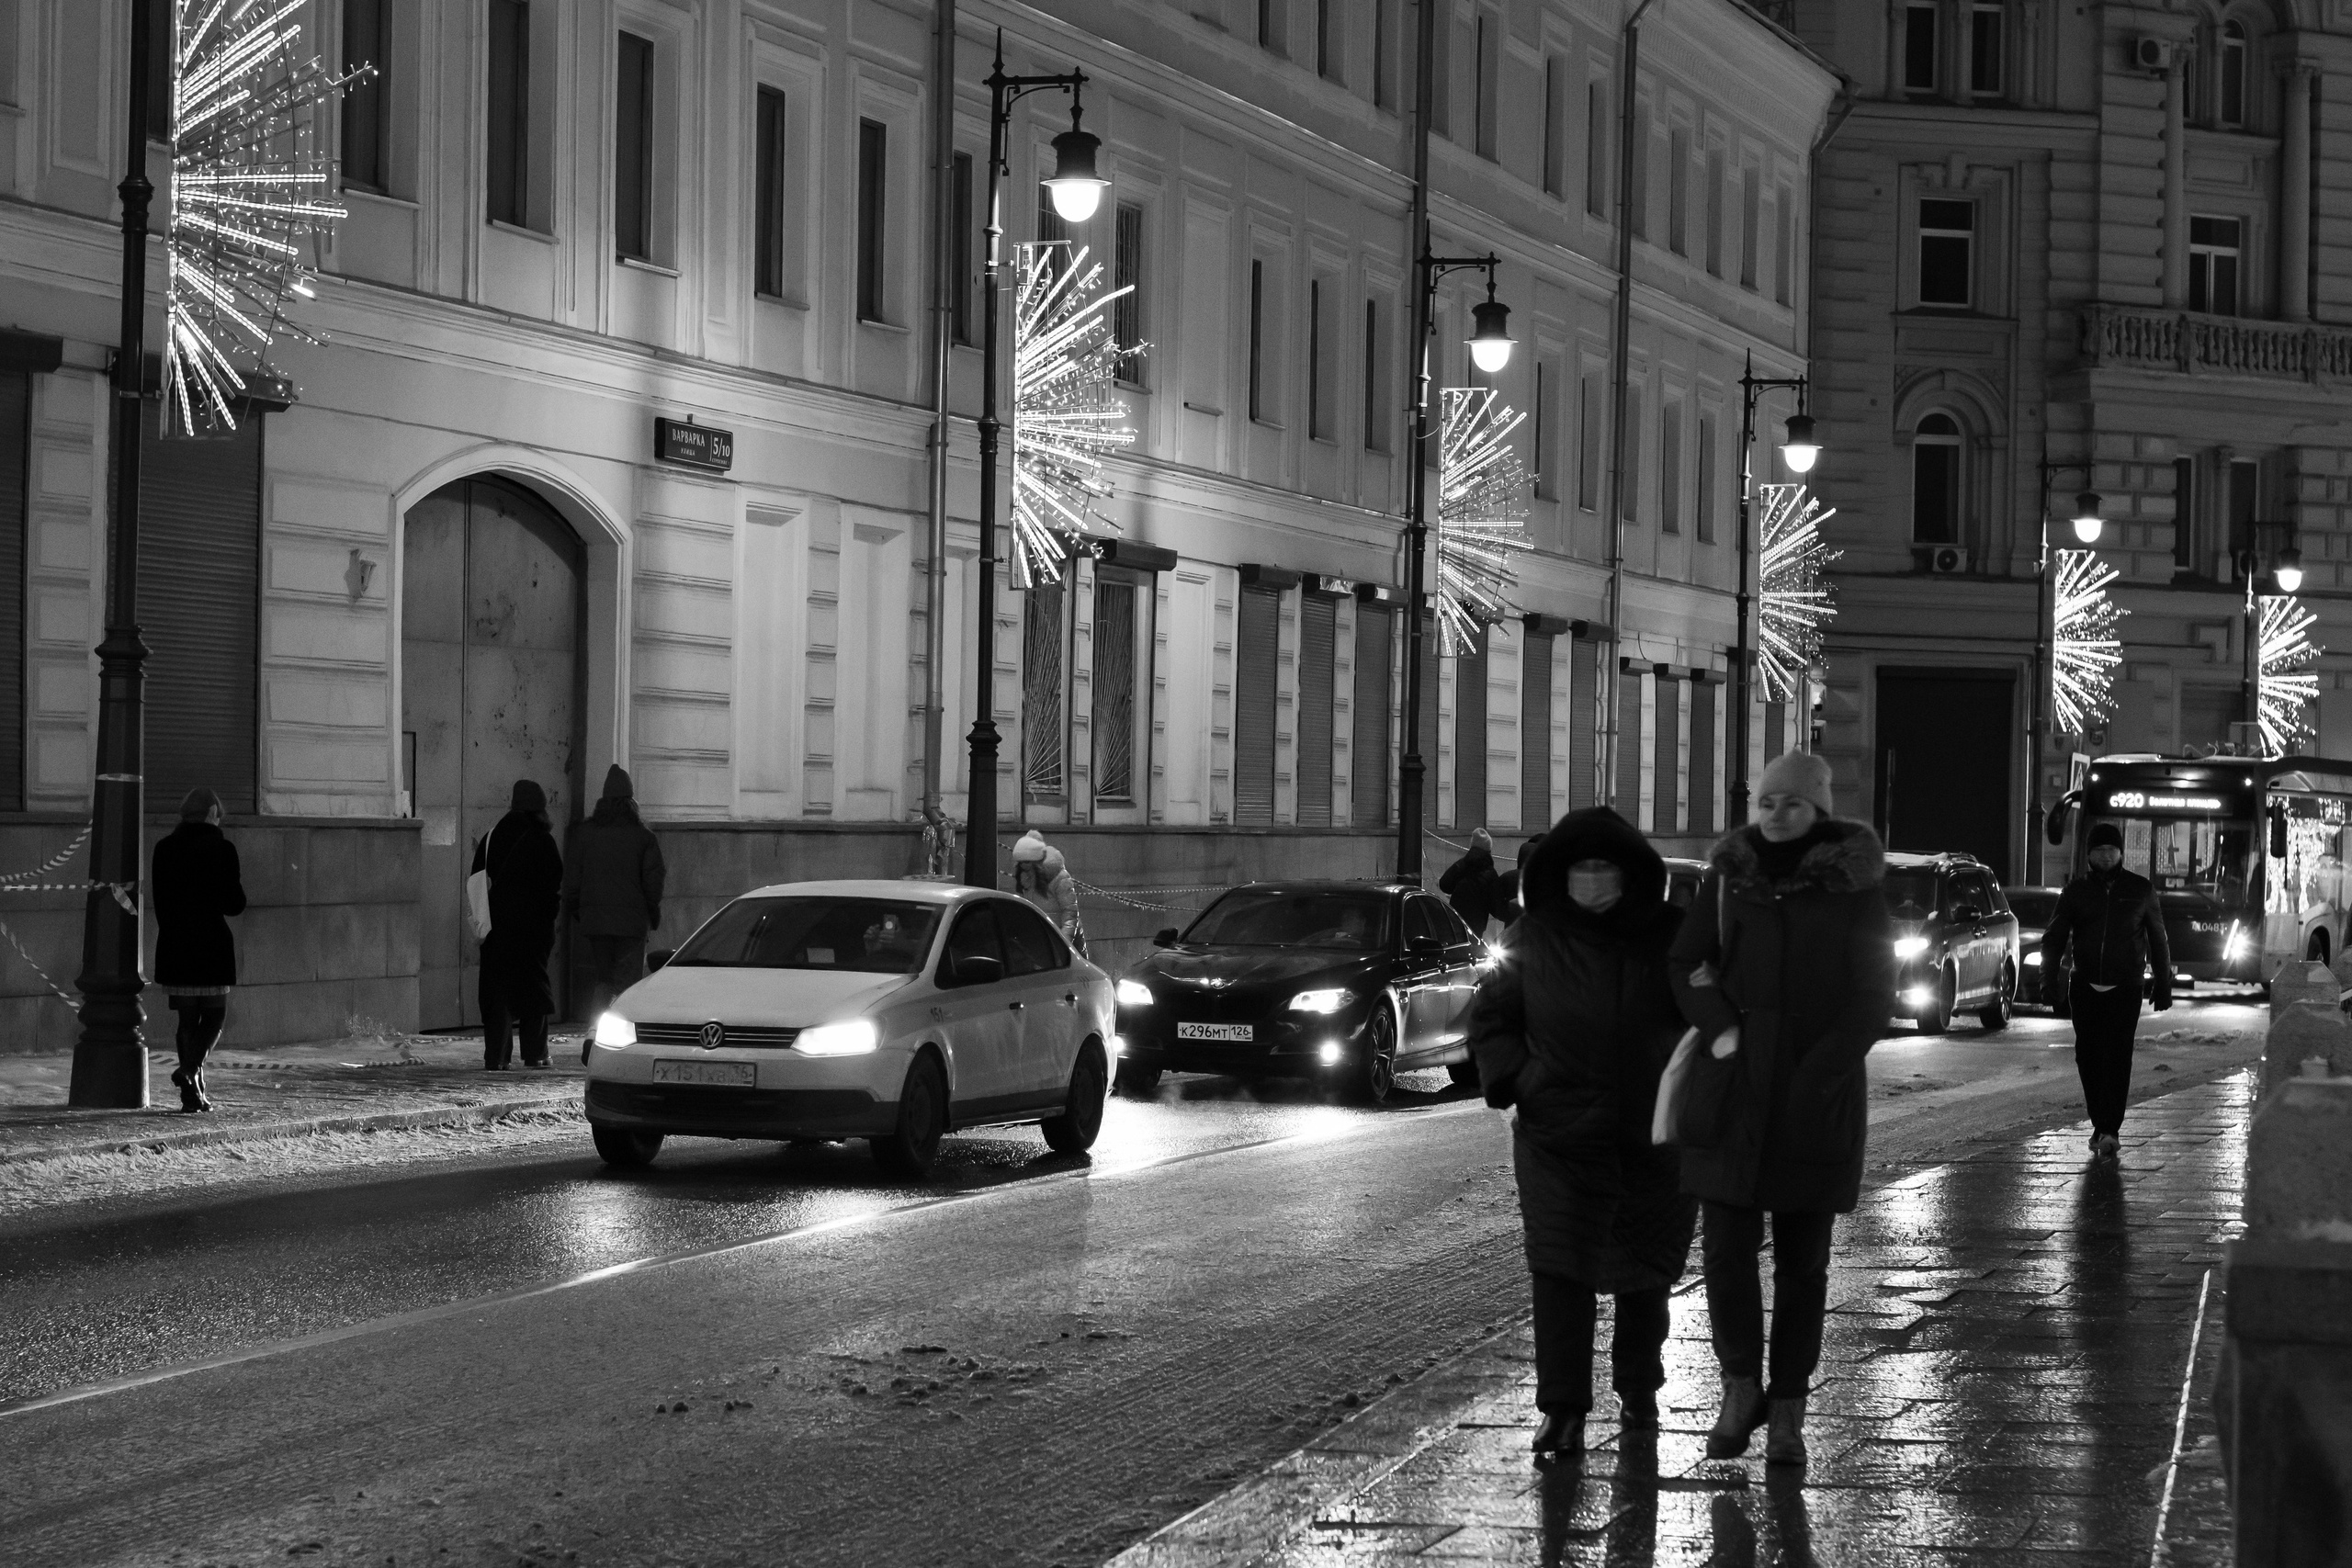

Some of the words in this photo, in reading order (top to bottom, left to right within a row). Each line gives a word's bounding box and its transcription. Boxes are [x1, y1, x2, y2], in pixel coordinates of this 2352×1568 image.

[673, 429, 705, 446] ВАРВАРКА
[681, 447, 695, 456] УЛИЦА
[713, 437, 730, 457] 5/10
[930, 1007, 944, 1022] 151
[1231, 1026, 1250, 1036] 126
